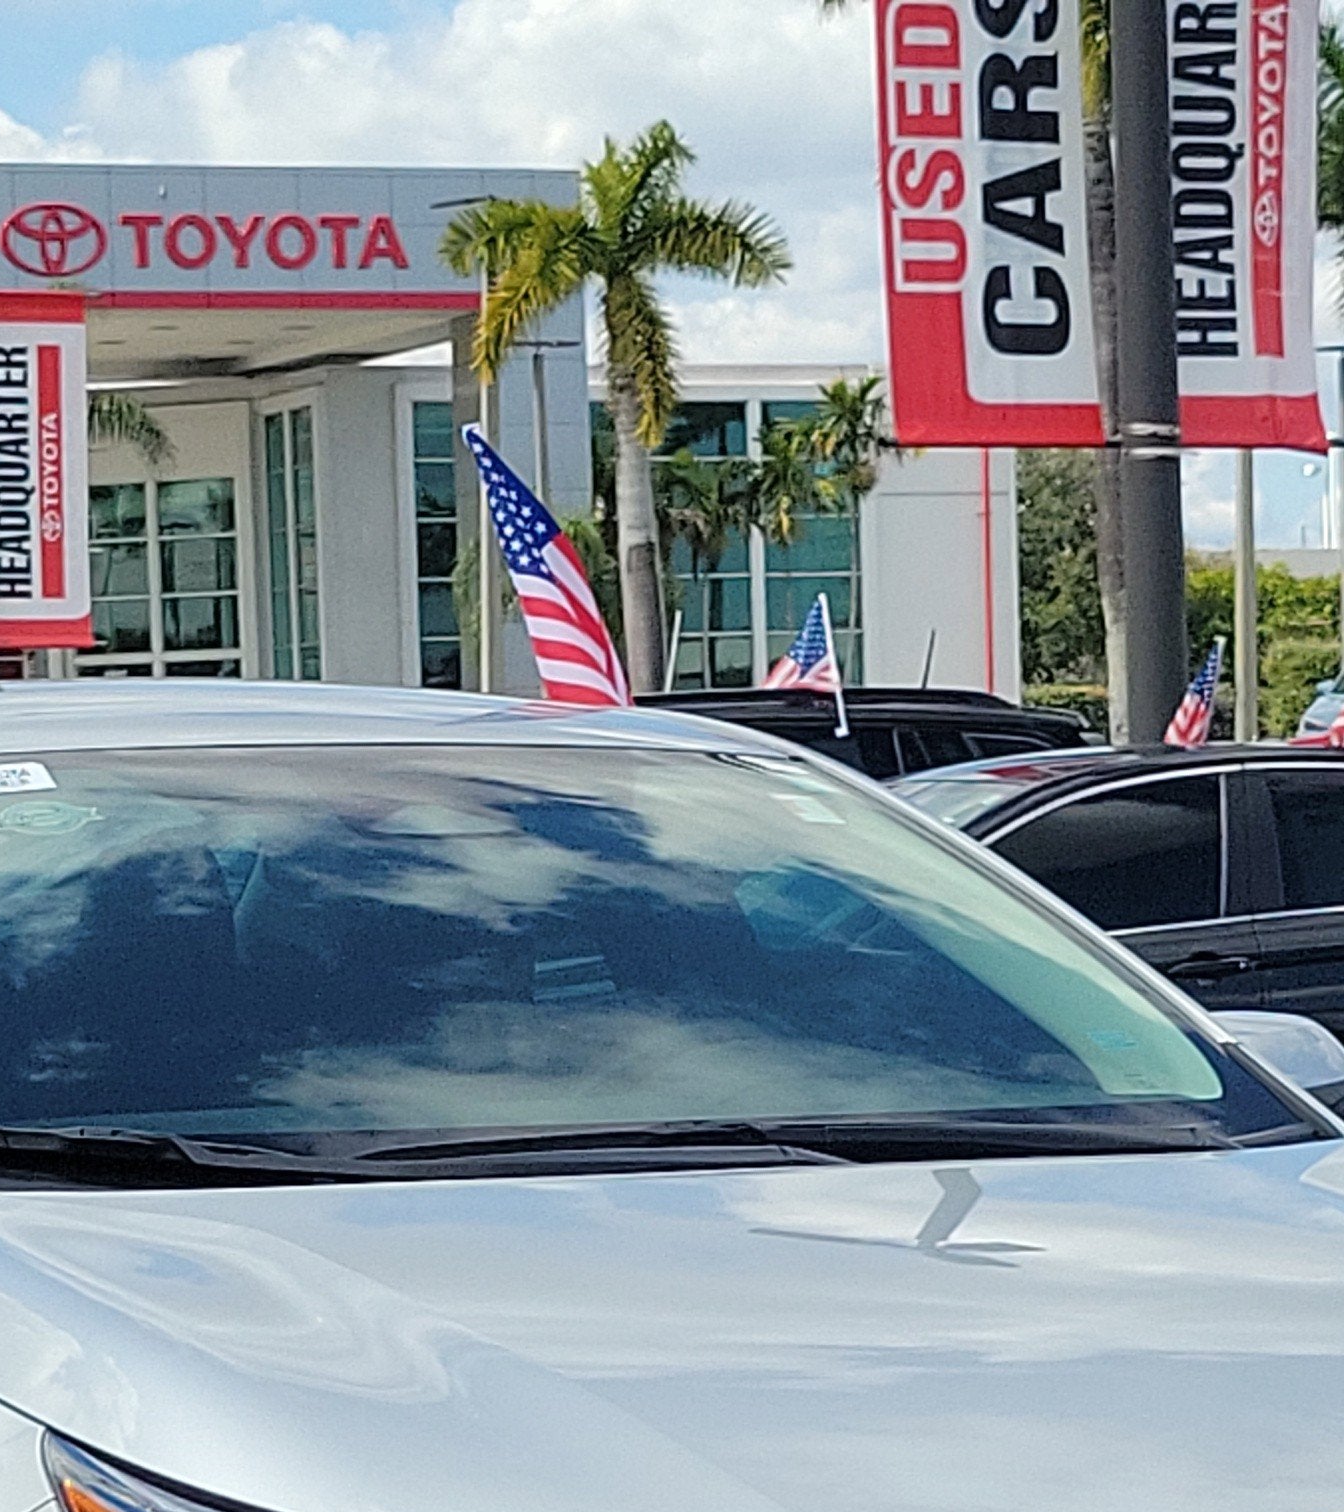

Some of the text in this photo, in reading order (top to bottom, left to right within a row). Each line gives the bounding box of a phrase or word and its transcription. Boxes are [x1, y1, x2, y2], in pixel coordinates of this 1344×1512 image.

[893, 3, 968, 287] USED
[1258, 3, 1286, 186] TOYOTA
[119, 213, 410, 271] TOYOTA
[41, 411, 61, 512] TOYOTA
